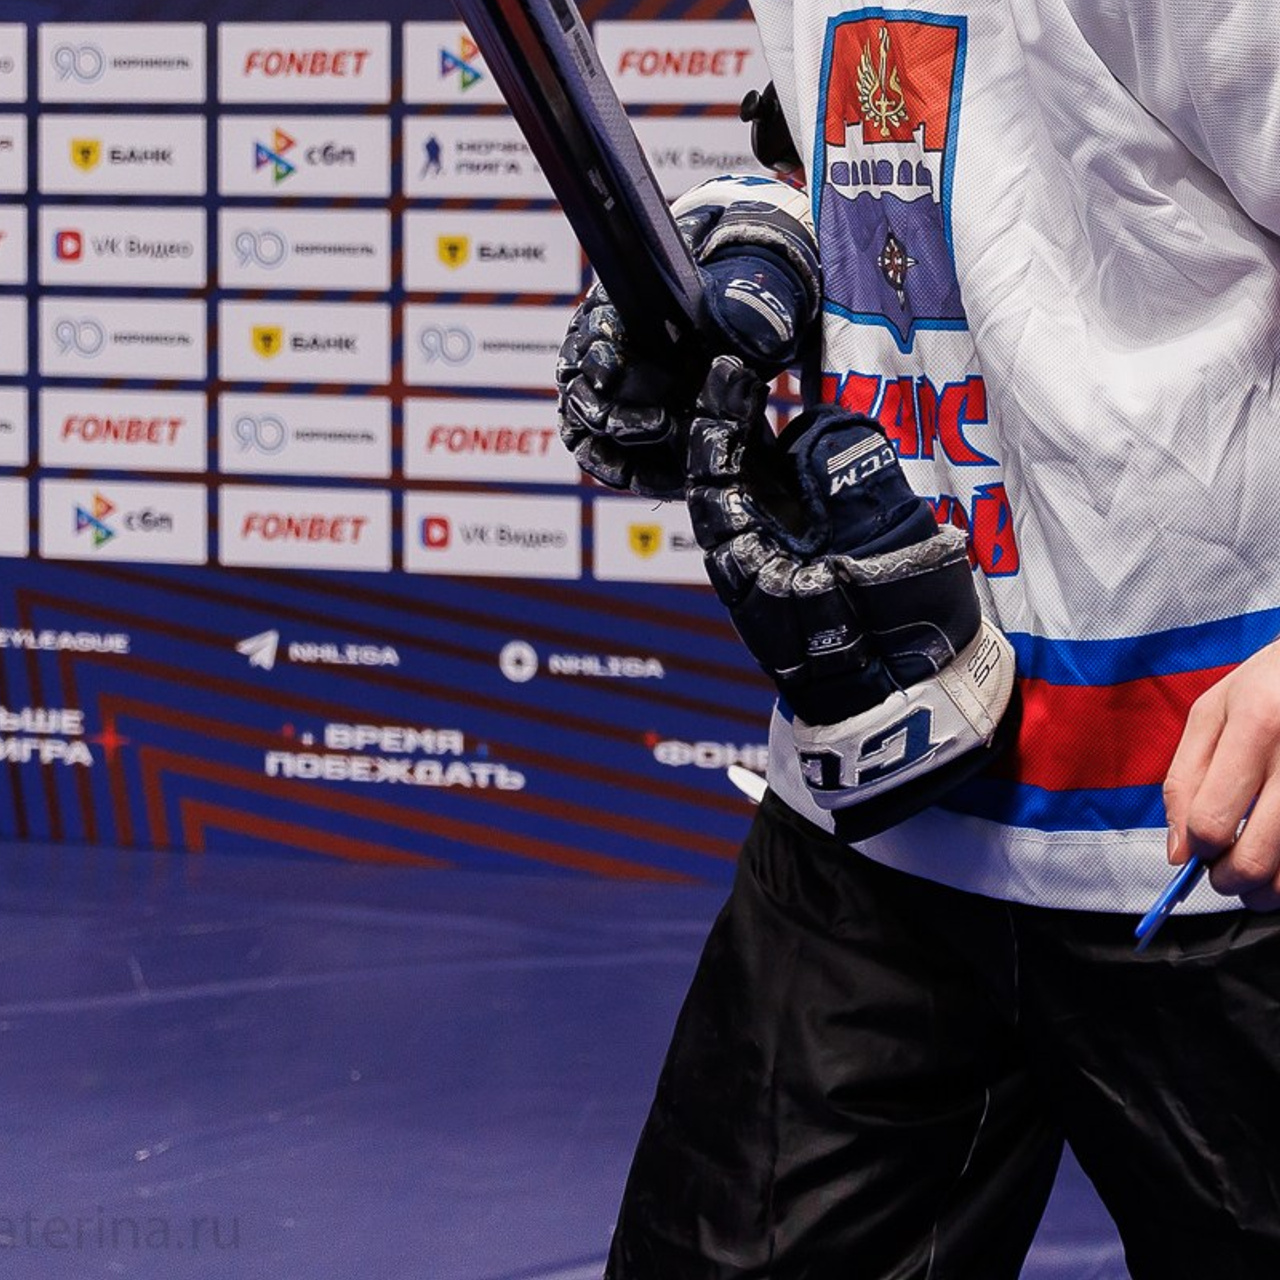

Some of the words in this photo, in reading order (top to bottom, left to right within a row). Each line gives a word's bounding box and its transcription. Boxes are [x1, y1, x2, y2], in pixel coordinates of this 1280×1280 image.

[244, 51, 370, 77] FONBET
[618, 50, 752, 76] FONBET
[61, 415, 185, 445] FONBET
[427, 425, 557, 456] FONBET
[829, 446, 896, 497] CCM
[241, 513, 369, 544] FONBET
[324, 723, 464, 766] ВРЕМЯ
[265, 751, 526, 791] ПОБЕЖДАТЬ
